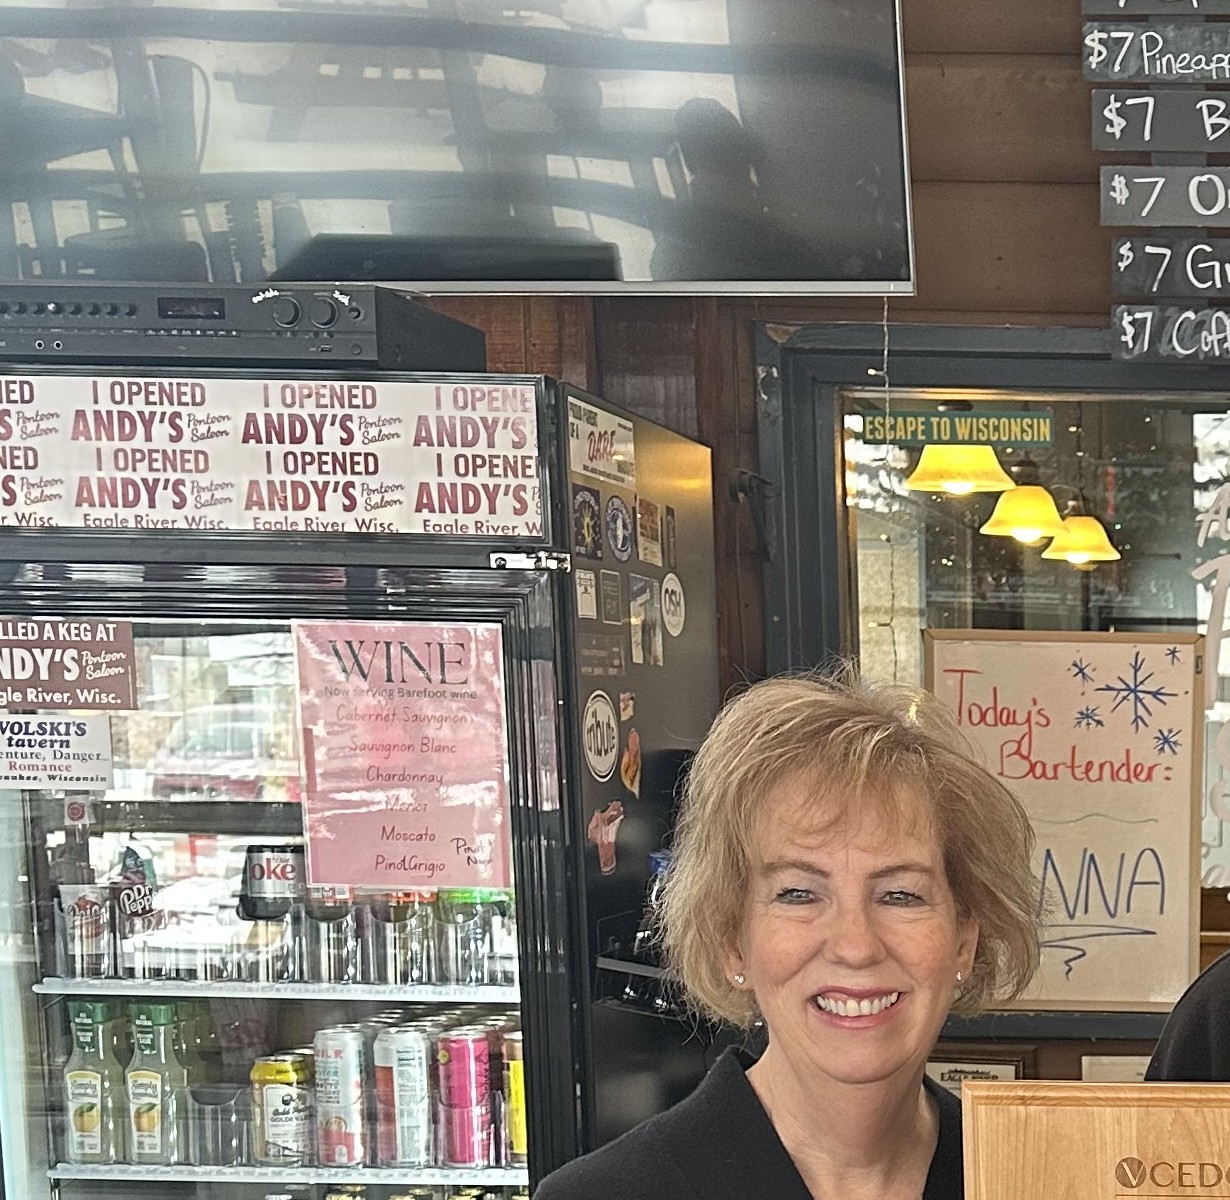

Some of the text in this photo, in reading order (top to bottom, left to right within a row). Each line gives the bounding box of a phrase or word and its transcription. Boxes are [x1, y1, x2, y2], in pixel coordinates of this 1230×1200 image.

[1084, 29, 1134, 72] $7
[1103, 94, 1154, 141] $7
[1110, 174, 1165, 216] $7
[1118, 241, 1172, 292] $7
[93, 380, 206, 406] I OPENED
[263, 384, 377, 409] I OPENED
[71, 410, 231, 443] ANDY'S Pontoon Saloon
[866, 416, 1050, 441] ESCAPE TO WISCONSIN
[43, 623, 117, 641] A KEG AT
[81, 651, 126, 681] Pontoon Saloon
[328, 640, 468, 685] WINE
[27, 687, 121, 705] River, Wisc.
[336, 704, 468, 729] Cabernet Sauvignon
[943, 669, 1051, 757] Today's
[7, 735, 71, 749] tavern
[350, 737, 457, 759] Sauvignon Blanc
[9, 761, 72, 772] Romance
[998, 739, 1173, 784] Bartender:
[366, 766, 443, 785] Chardonnay
[381, 825, 436, 842] Moscato
